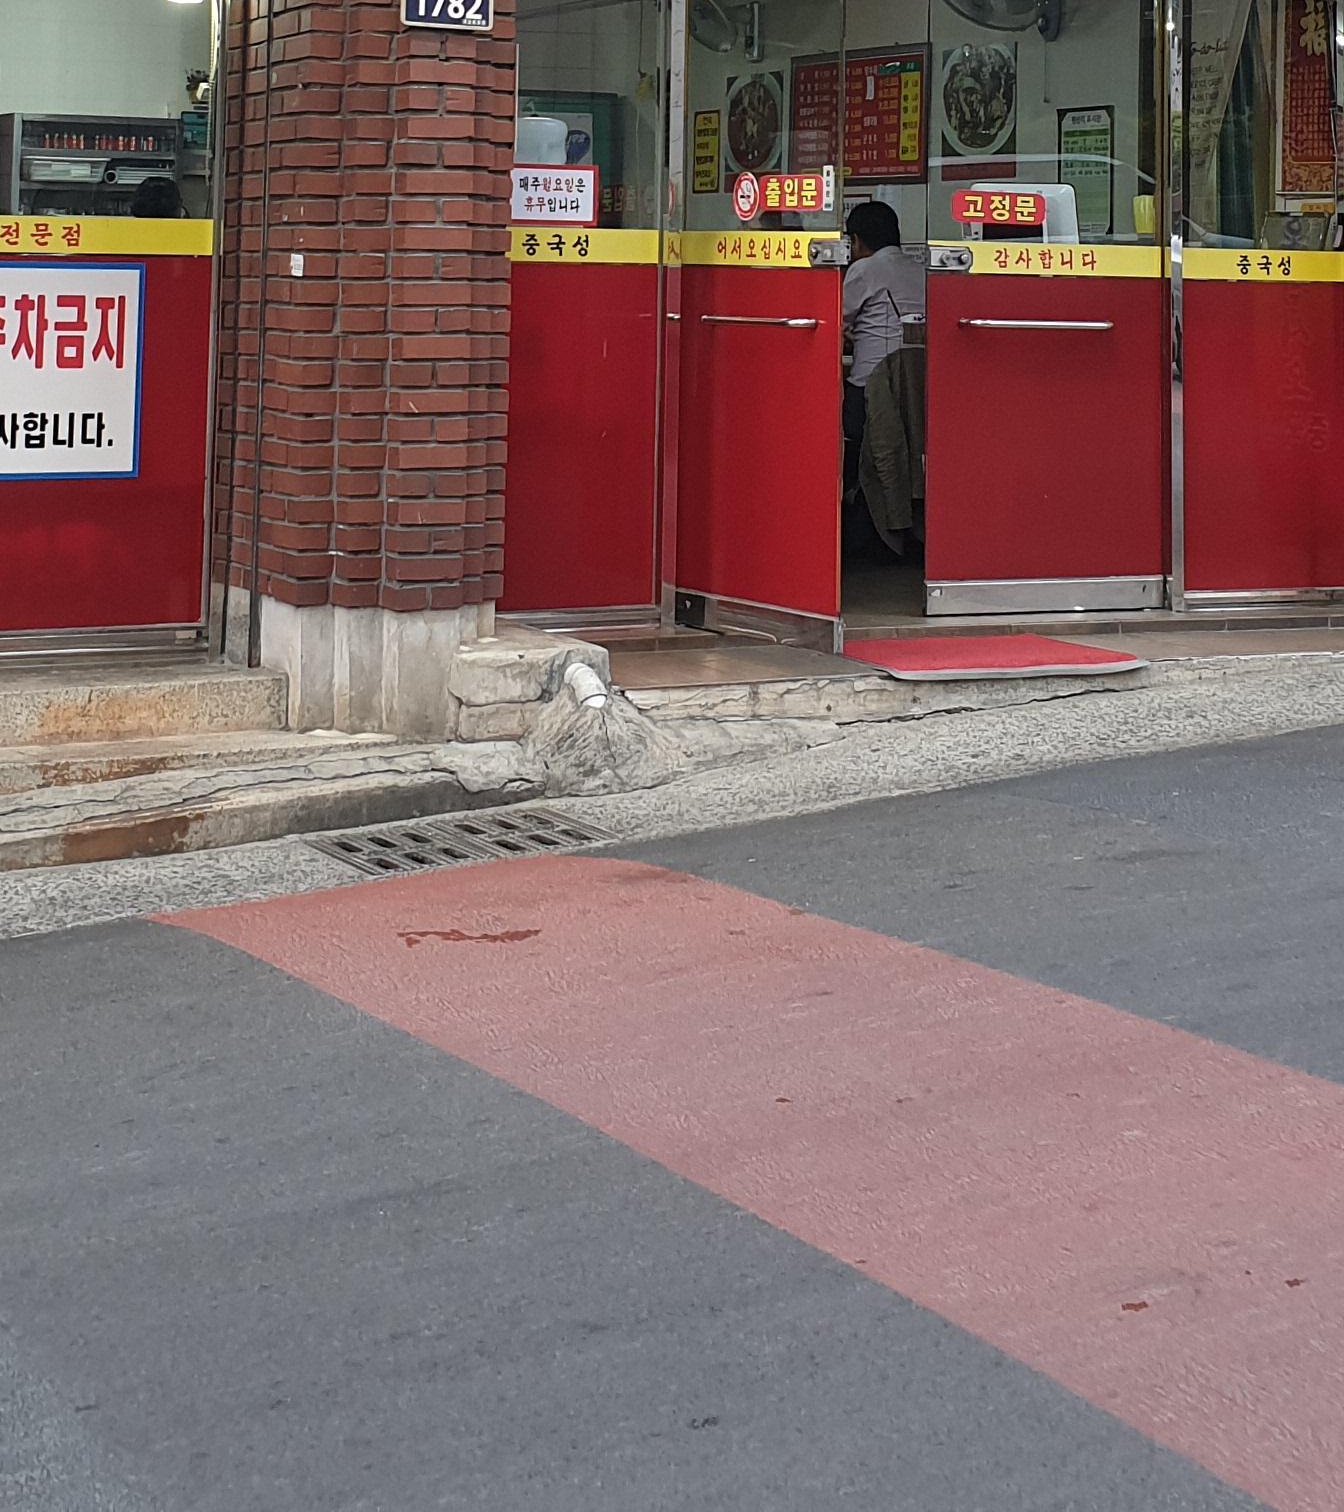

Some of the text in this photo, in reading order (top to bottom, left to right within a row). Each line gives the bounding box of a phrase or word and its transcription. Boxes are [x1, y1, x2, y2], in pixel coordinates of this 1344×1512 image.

[765, 178, 817, 208] 출입문
[524, 197, 580, 213] 휴무입니다
[962, 195, 1037, 222] 고정문
[522, 234, 590, 257] 중국성
[717, 236, 803, 261] 어서오십시요
[993, 248, 1097, 270] 감사합니다
[1236, 254, 1292, 276] 중국성
